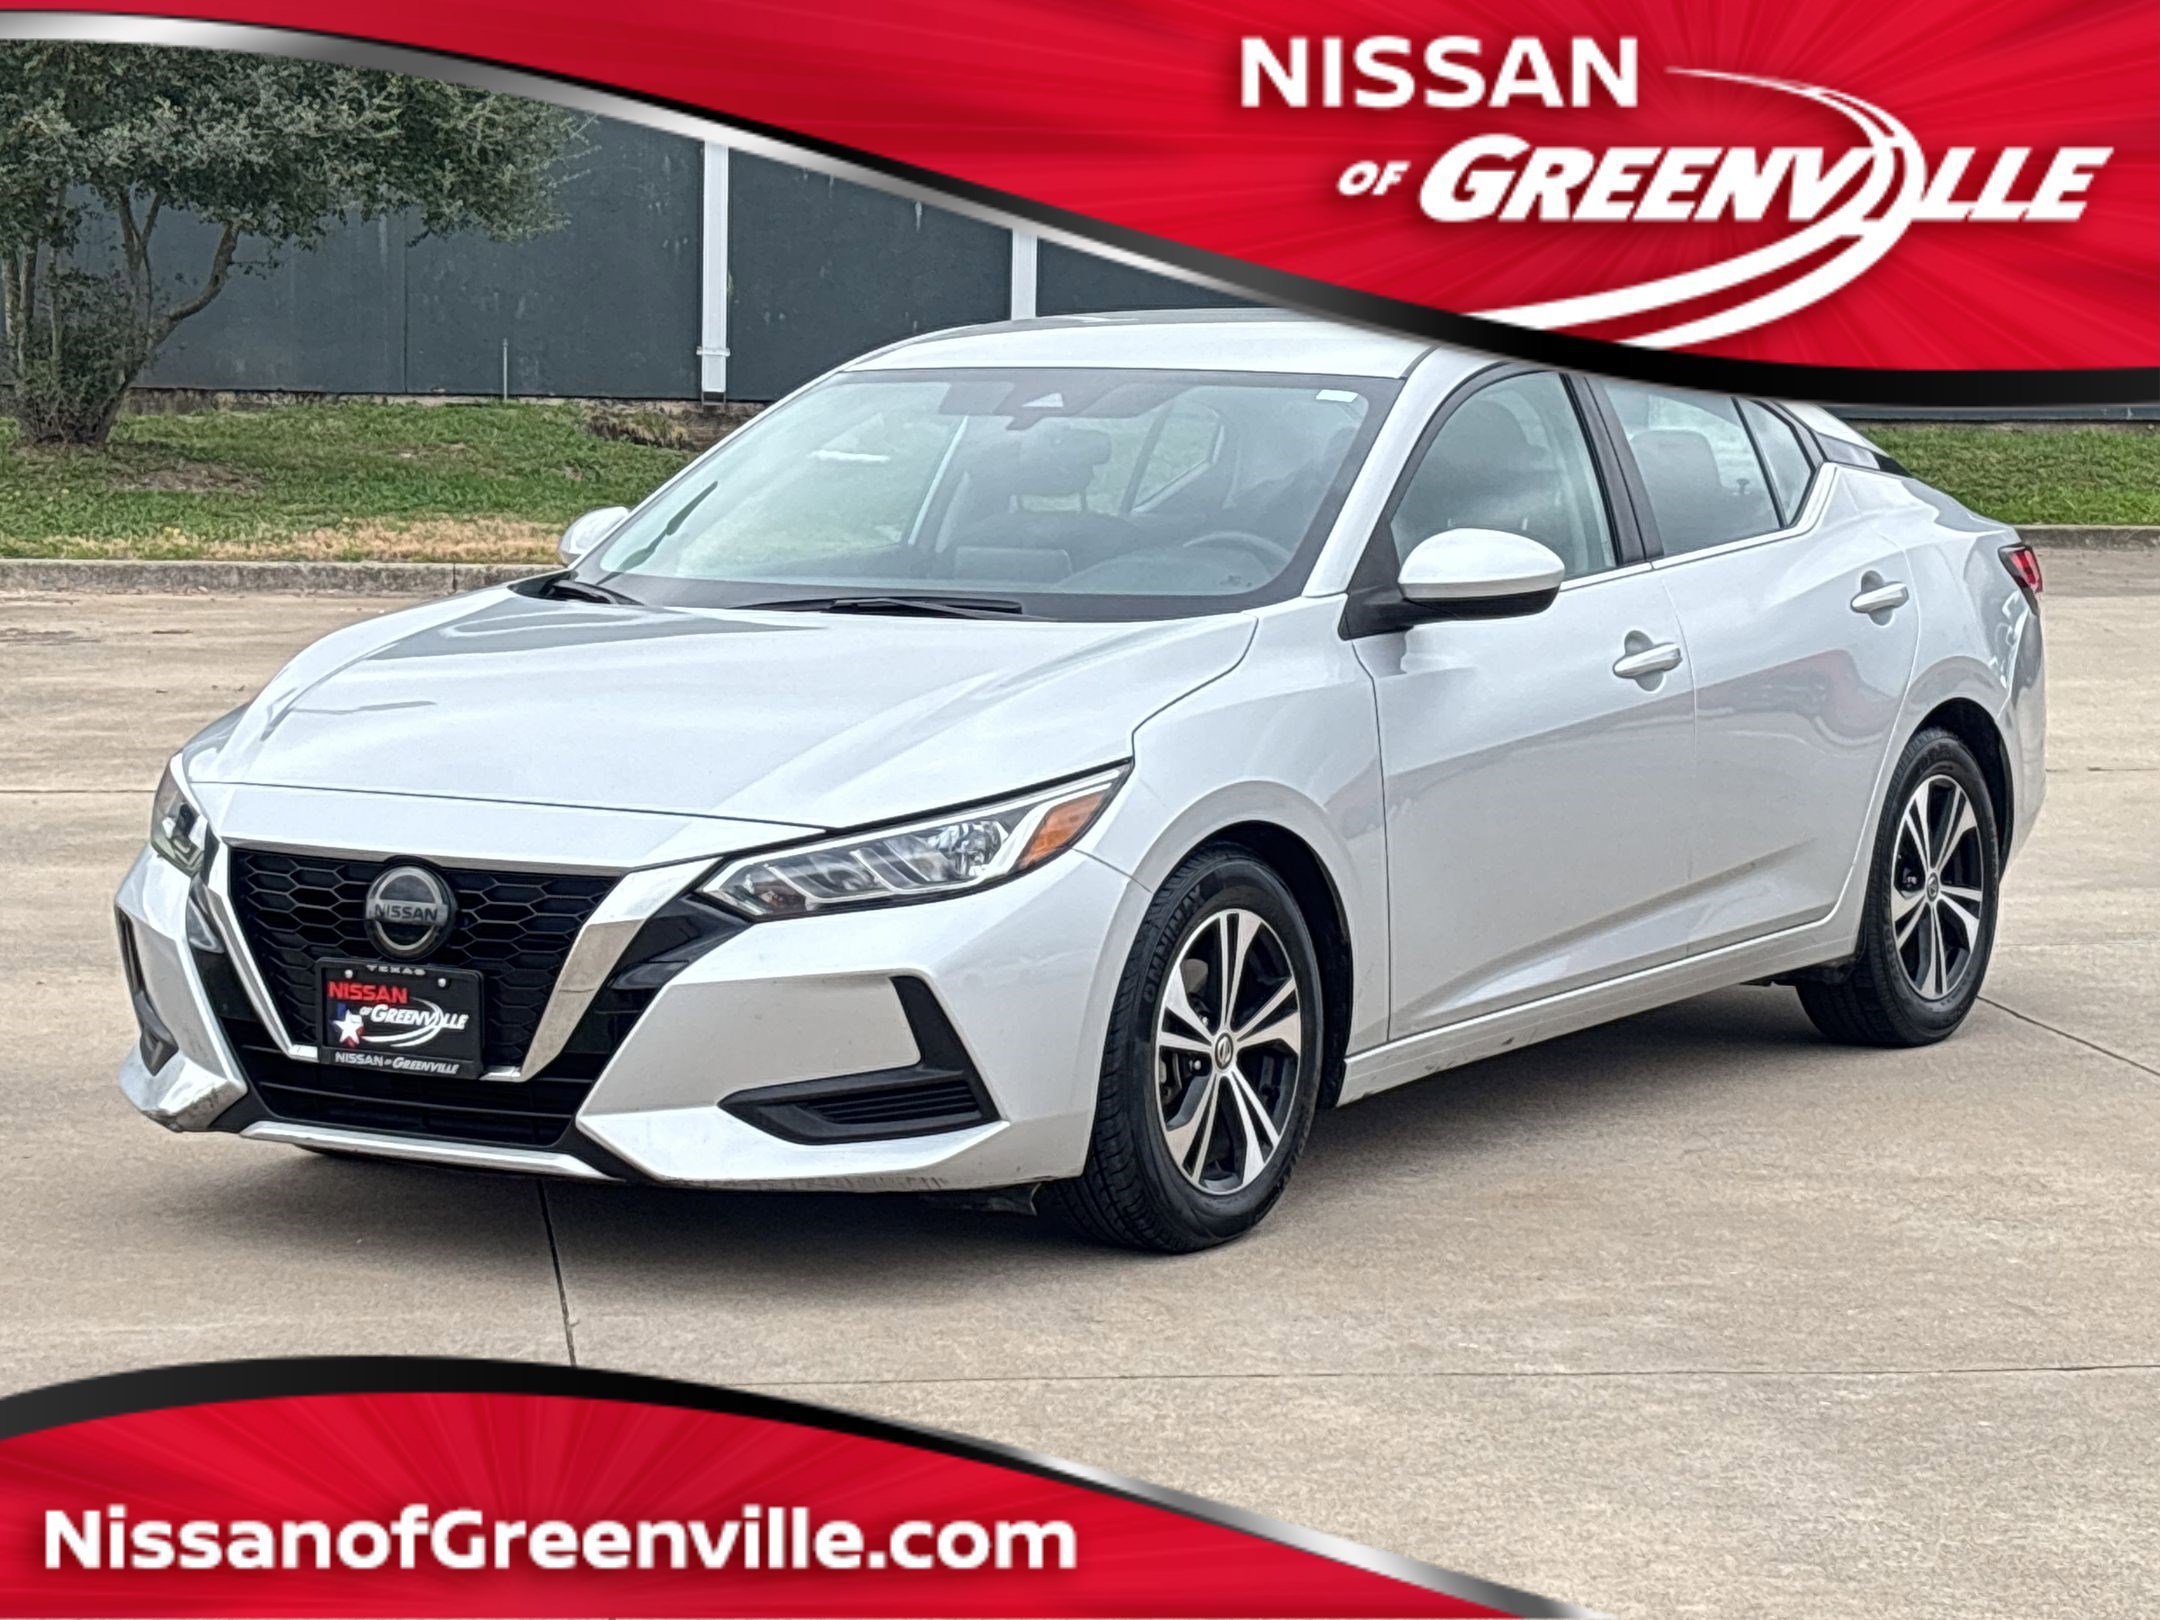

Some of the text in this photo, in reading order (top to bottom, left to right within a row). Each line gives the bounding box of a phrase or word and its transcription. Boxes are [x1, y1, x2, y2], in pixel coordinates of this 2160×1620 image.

[374, 903, 438, 921] NISSAN
[366, 963, 427, 976] TEXAS
[328, 981, 408, 1004] NISSAN
[335, 1051, 385, 1067] NISSAN
[392, 1057, 460, 1075] GREENVILLE
